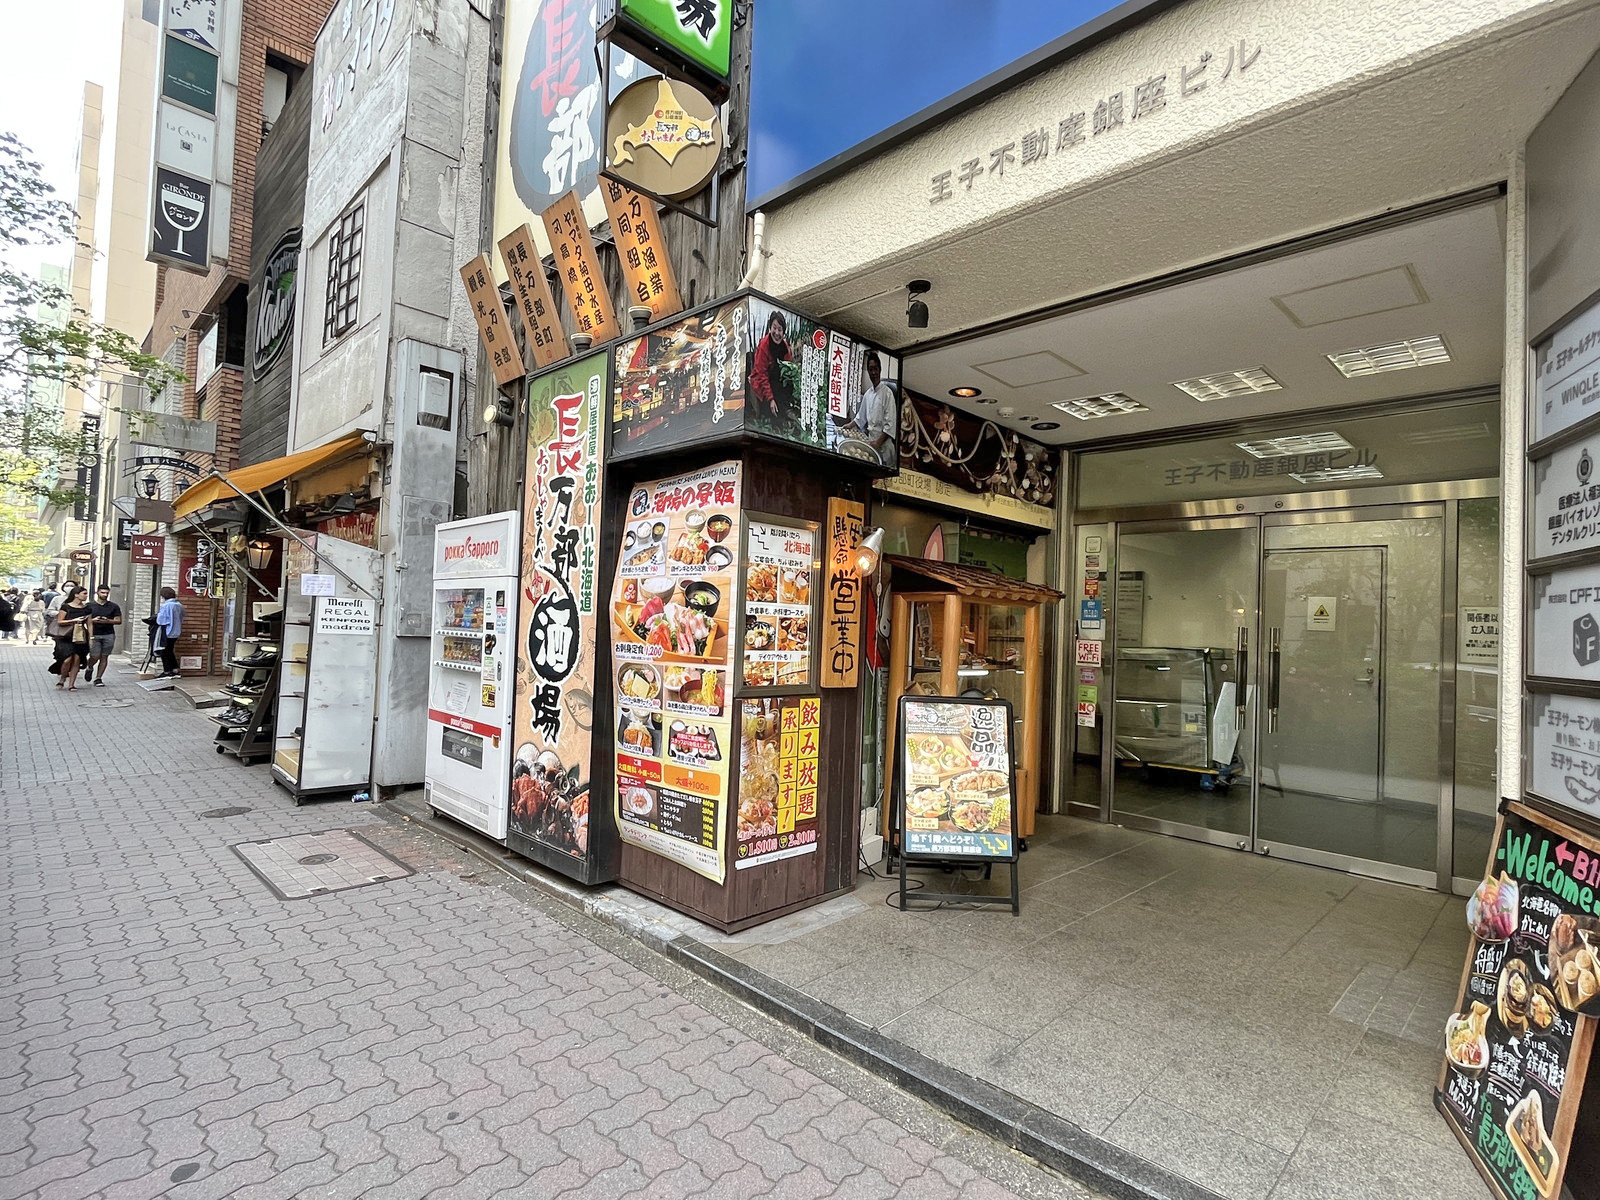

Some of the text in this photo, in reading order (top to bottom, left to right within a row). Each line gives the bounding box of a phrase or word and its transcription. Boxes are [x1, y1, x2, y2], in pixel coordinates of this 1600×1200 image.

[185, 31, 200, 40] 3F
[929, 39, 1261, 205] 王子不動産銀座ビル
[178, 125, 208, 143] CASTA
[162, 183, 205, 202] GIRONDE
[1165, 447, 1378, 487] 王子不動産銀座ビル
[652, 479, 736, 514] 酒場の昼飯
[784, 540, 811, 555] 北海道
[324, 608, 369, 616] REGAL
[829, 568, 860, 680] 営業中
[1078, 643, 1099, 653] FREE
[1078, 653, 1099, 662] Wi-Fi
[797, 700, 819, 817] 飲み放題
[1521, 914, 1550, 940] かにめし
